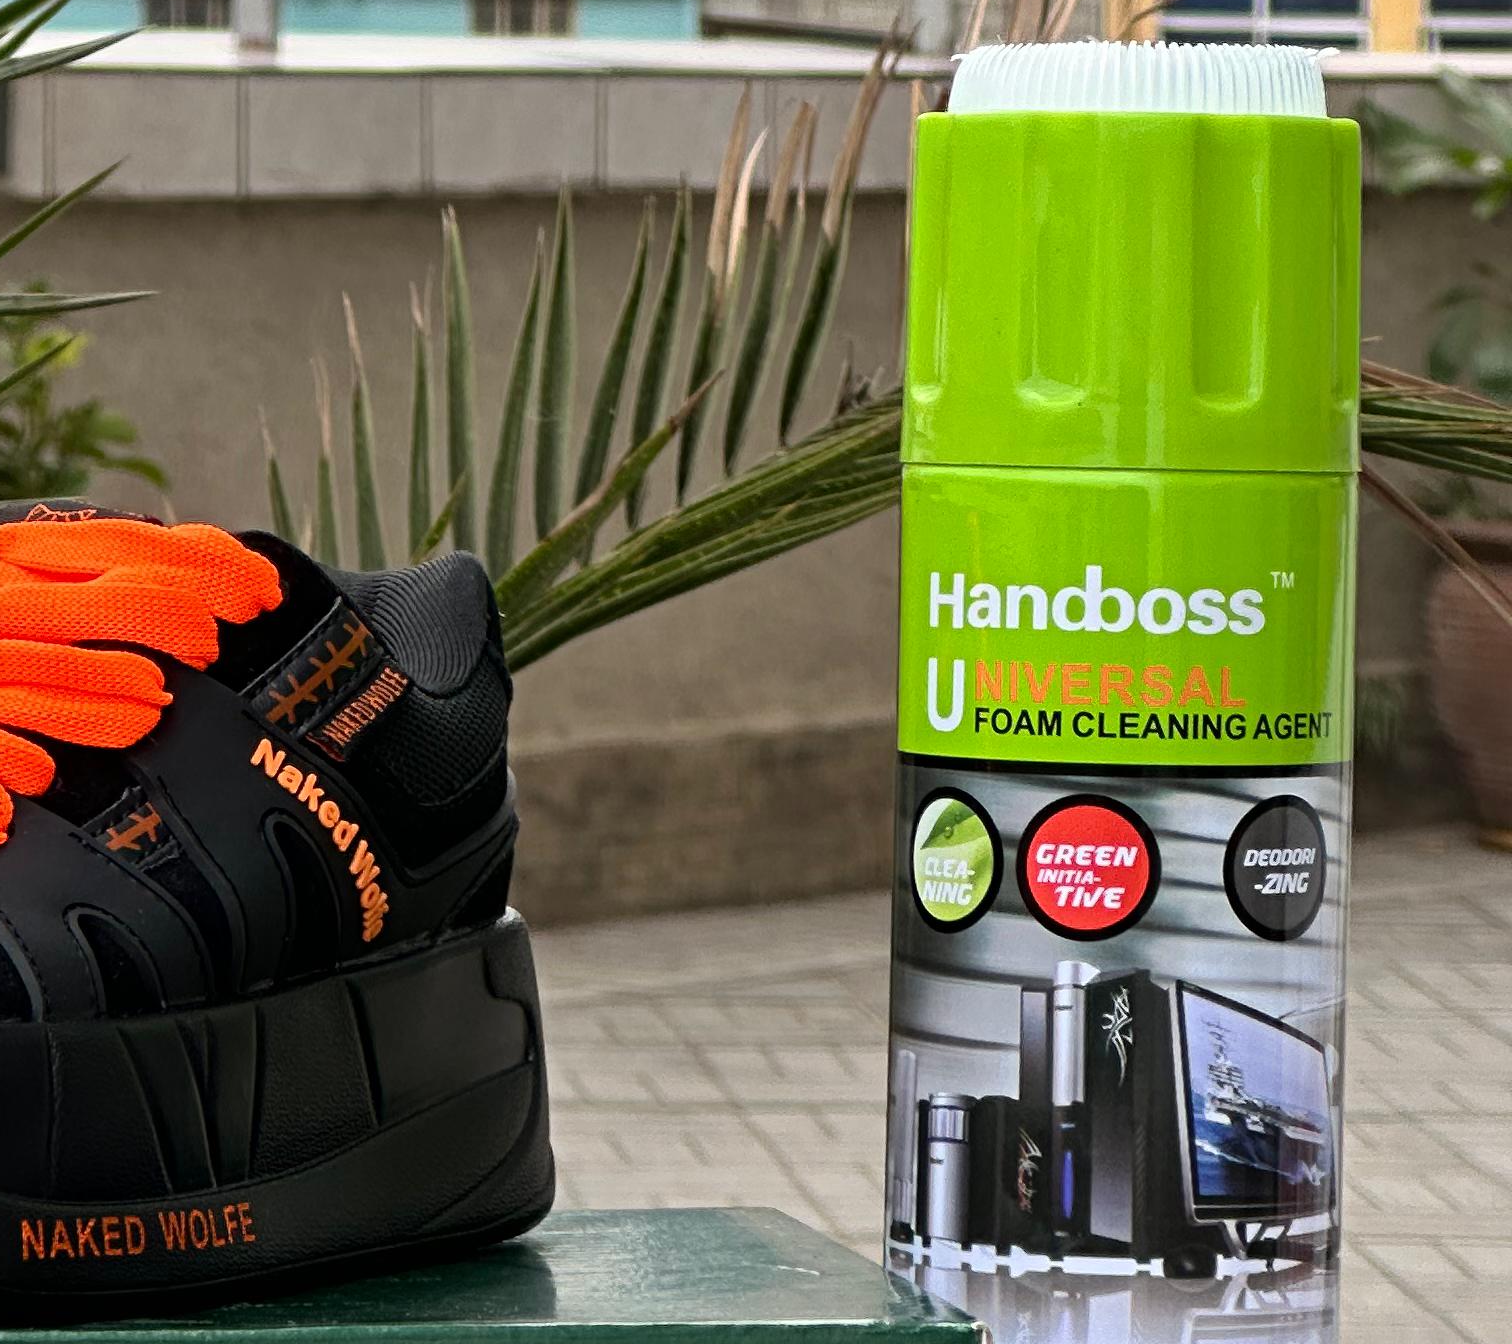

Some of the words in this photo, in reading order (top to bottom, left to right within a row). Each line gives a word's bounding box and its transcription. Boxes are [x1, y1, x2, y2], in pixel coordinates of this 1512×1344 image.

[929, 564, 1266, 635] Handboss
[974, 707, 1062, 737] FOAM
[1072, 711, 1248, 741] CLEANING
[1253, 712, 1333, 740] AGENT
[250, 738, 359, 852] Naked
[1036, 843, 1139, 868] GREEN
[1243, 847, 1317, 868] DEODORI
[923, 881, 973, 906] NING
[1055, 886, 1126, 910] TIVE
[20, 1216, 145, 1260] NAKED
[157, 1201, 256, 1250] WOLFE
